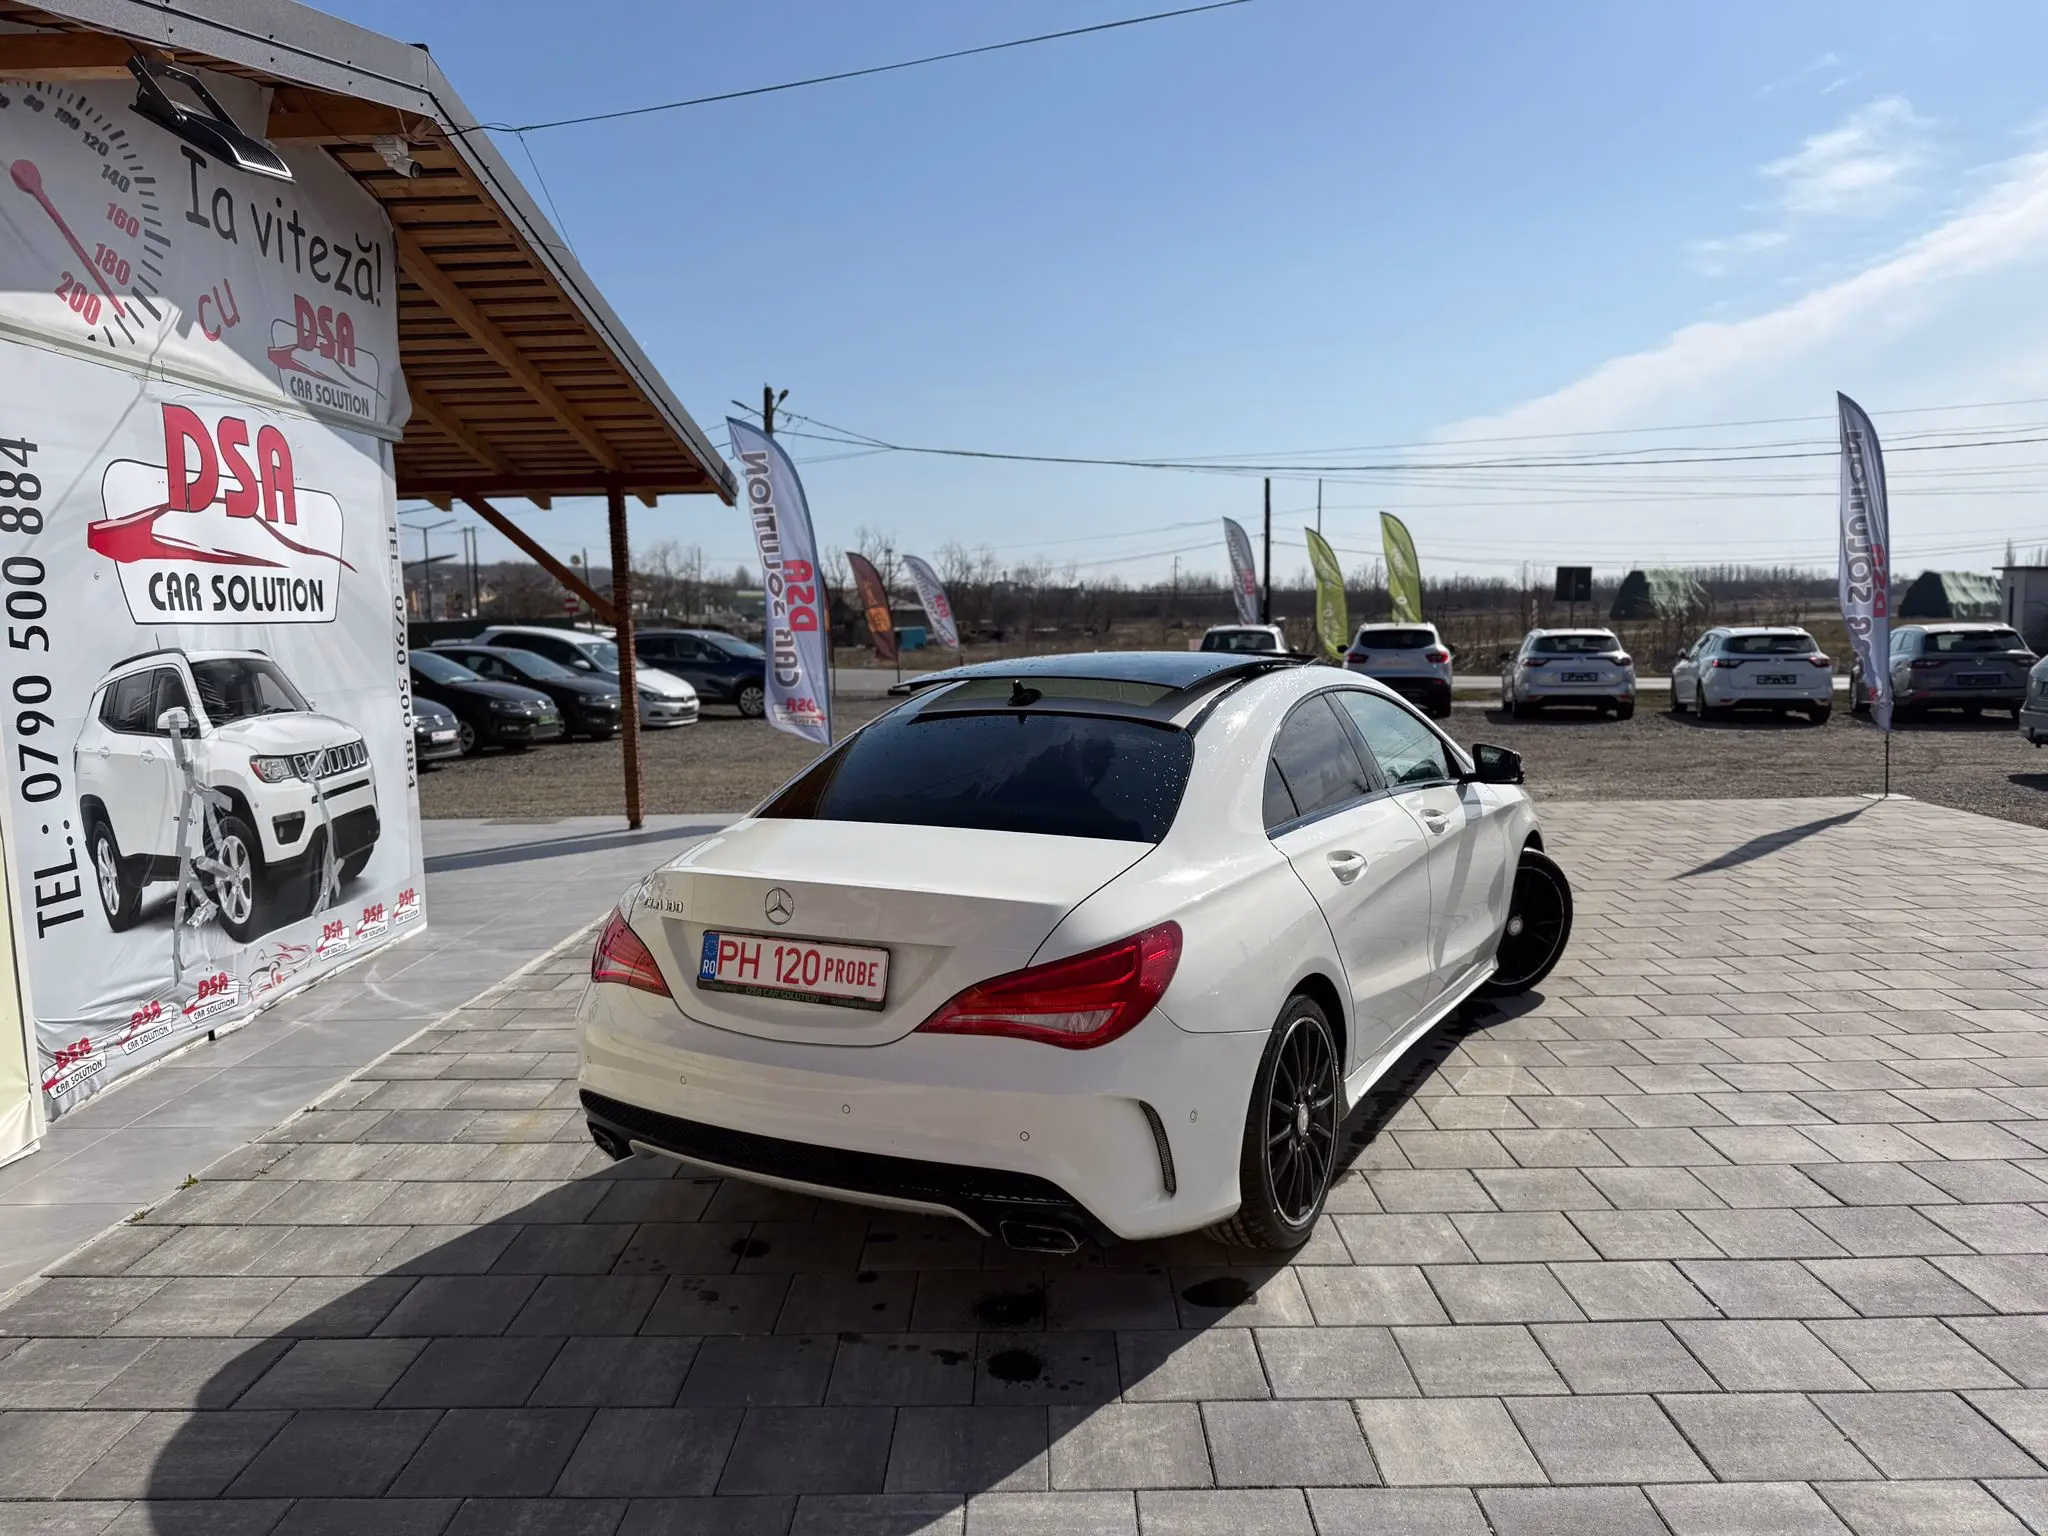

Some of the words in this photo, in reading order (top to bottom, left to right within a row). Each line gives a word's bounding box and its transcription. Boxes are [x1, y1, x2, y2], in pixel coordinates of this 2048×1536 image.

[54, 107, 81, 130] 100
[82, 131, 109, 157] 120
[101, 164, 130, 193] 140
[106, 202, 140, 238] 160
[181, 145, 238, 245] Ia
[250, 197, 381, 307] viteză!
[95, 242, 131, 286] 180
[54, 271, 102, 326] 200
[293, 293, 356, 368] DSA
[290, 376, 313, 401] CAR
[315, 384, 369, 417] SOLUTION
[161, 402, 298, 526] DSA
[0, 437, 44, 535] 884
[2, 556, 49, 653] 500
[148, 571, 203, 612] CAR
[211, 574, 324, 613] SOLUTION
[394, 596, 407, 665] 0790
[398, 677, 412, 728] 500
[12, 675, 62, 803] 0790
[33, 819, 84, 939] TEL.:
[400, 888, 414, 907] DSA
[323, 919, 343, 940] DSA
[363, 903, 383, 924] DSA
[702, 959, 717, 975] RO
[716, 939, 762, 979] PH
[774, 946, 821, 986] 120
[823, 957, 879, 987] PROBE
[198, 972, 228, 1000] DSA
[131, 1000, 161, 1030] DSA
[193, 1010, 205, 1020] CAR
[207, 997, 235, 1015] SOLUTION
[127, 1039, 140, 1051] CAR
[140, 1025, 169, 1045] SOLUTION
[56, 1080, 70, 1094] CAR
[70, 1059, 103, 1085] SOLUTION
